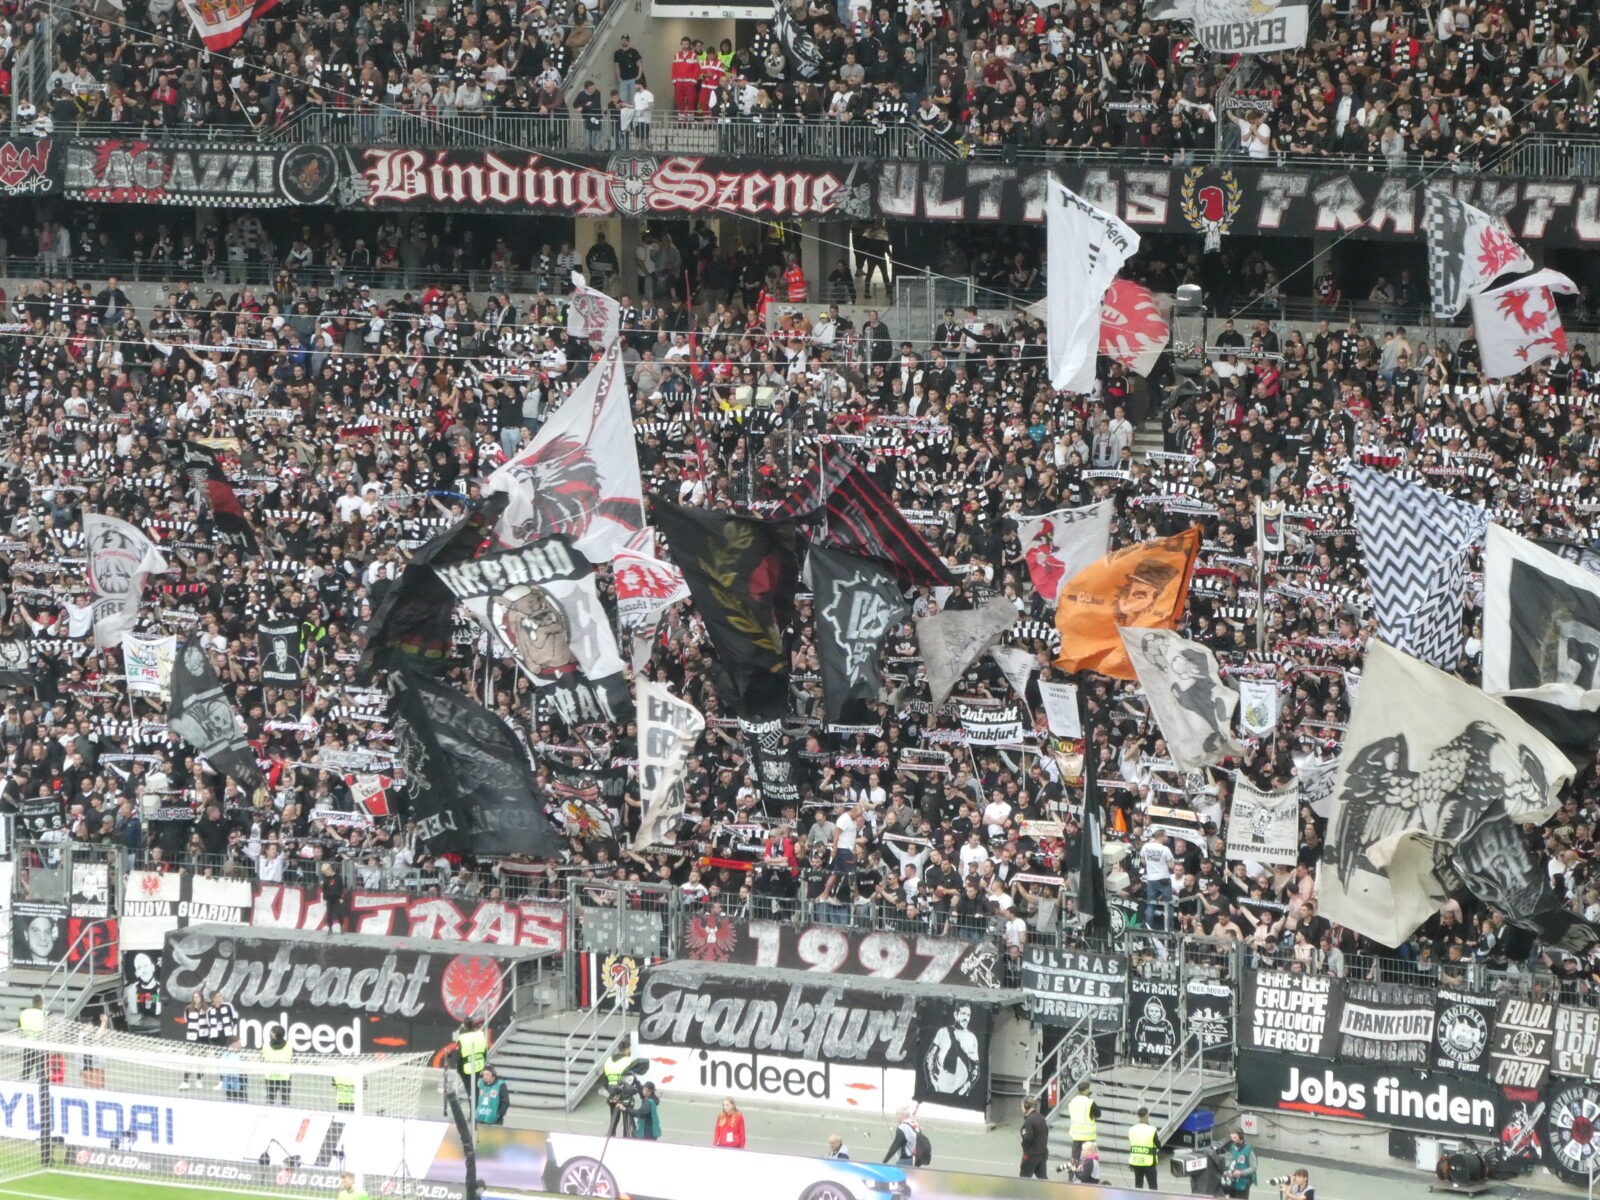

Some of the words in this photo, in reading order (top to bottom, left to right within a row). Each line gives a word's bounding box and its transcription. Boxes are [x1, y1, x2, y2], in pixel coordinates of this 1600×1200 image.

[64, 148, 275, 193] RAGAZZI
[363, 149, 615, 215] Binding
[650, 156, 841, 214] Szene
[1150, 452, 1186, 461] Eintracht
[1087, 470, 1124, 478] Eintracht
[960, 704, 1018, 723] Eintracht
[907, 749, 946, 759] Eintracht
[125, 901, 170, 917] NUOVA
[178, 902, 242, 923] GUARDIA
[749, 921, 968, 984] 1997
[1032, 950, 1119, 974] ULTRAS
[165, 934, 431, 1017] Eintracht
[1037, 973, 1111, 997] NEVER
[1256, 970, 1292, 988] EHRE
[1302, 974, 1331, 993] DER
[1132, 980, 1178, 997] EXTREME
[1022, 999, 1119, 1022] SURRENDER
[1255, 987, 1329, 1016] GRUPPE
[640, 971, 917, 1061] Frankfurt
[1253, 1009, 1325, 1034] STADION
[1346, 1010, 1433, 1036] FRANKFURT
[1501, 1000, 1553, 1029] FULDA
[239, 1012, 361, 1055] ndeed
[1253, 1026, 1323, 1054] VERBOT
[1501, 1034, 1511, 1049] 3
[1535, 1040, 1546, 1054] 6
[1138, 1043, 1173, 1055] FANS
[1341, 1034, 1427, 1063] HOOLIGANS
[1558, 1051, 1586, 1073] 64
[700, 1051, 831, 1100] indeed
[1496, 1061, 1545, 1088] CREW
[1280, 1067, 1366, 1111] Jobs
[1374, 1076, 1495, 1127] finden
[89, 1152, 106, 1165] LG
[108, 1154, 137, 1168] OLED
[188, 1163, 205, 1177] LG
[206, 1165, 238, 1180] OLED
[290, 1173, 308, 1187] LG
[309, 1174, 341, 1190] OLED
